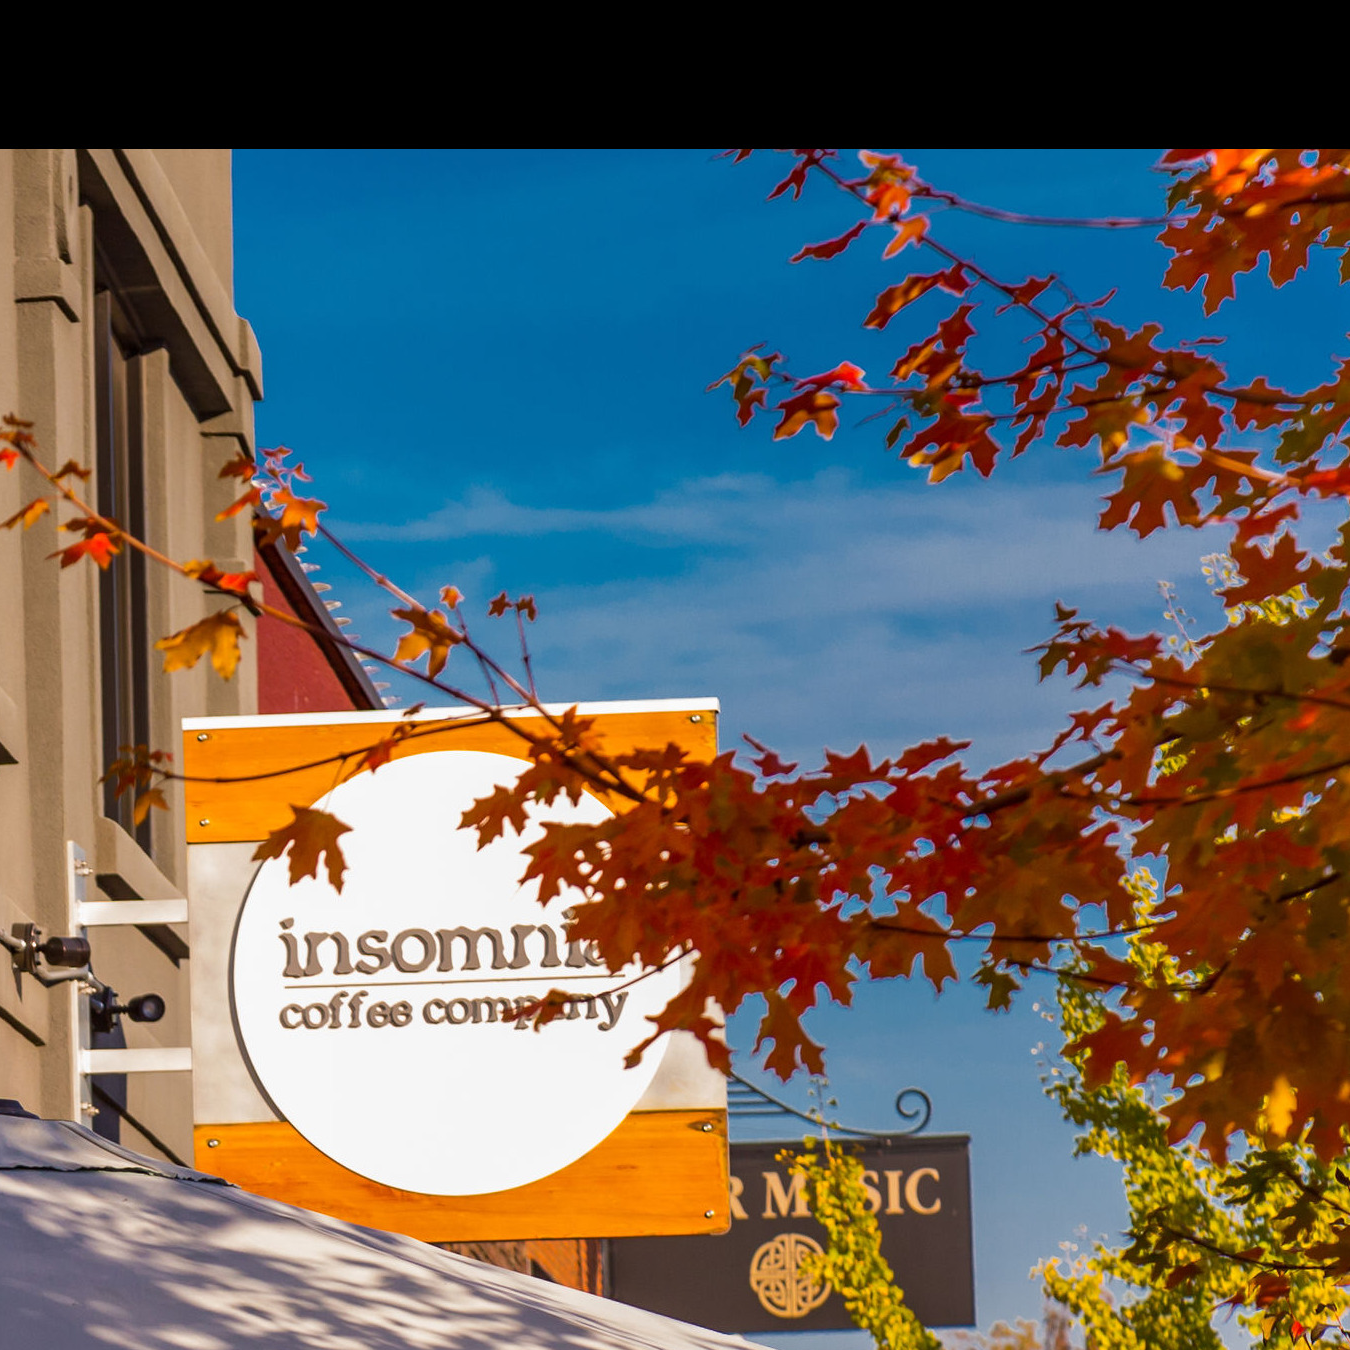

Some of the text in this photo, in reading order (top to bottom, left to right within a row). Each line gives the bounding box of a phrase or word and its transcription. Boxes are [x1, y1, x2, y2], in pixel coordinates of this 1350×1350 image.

[279, 907, 607, 979] insomni
[279, 990, 629, 1032] coffee compny
[762, 1167, 941, 1219] MSIC
